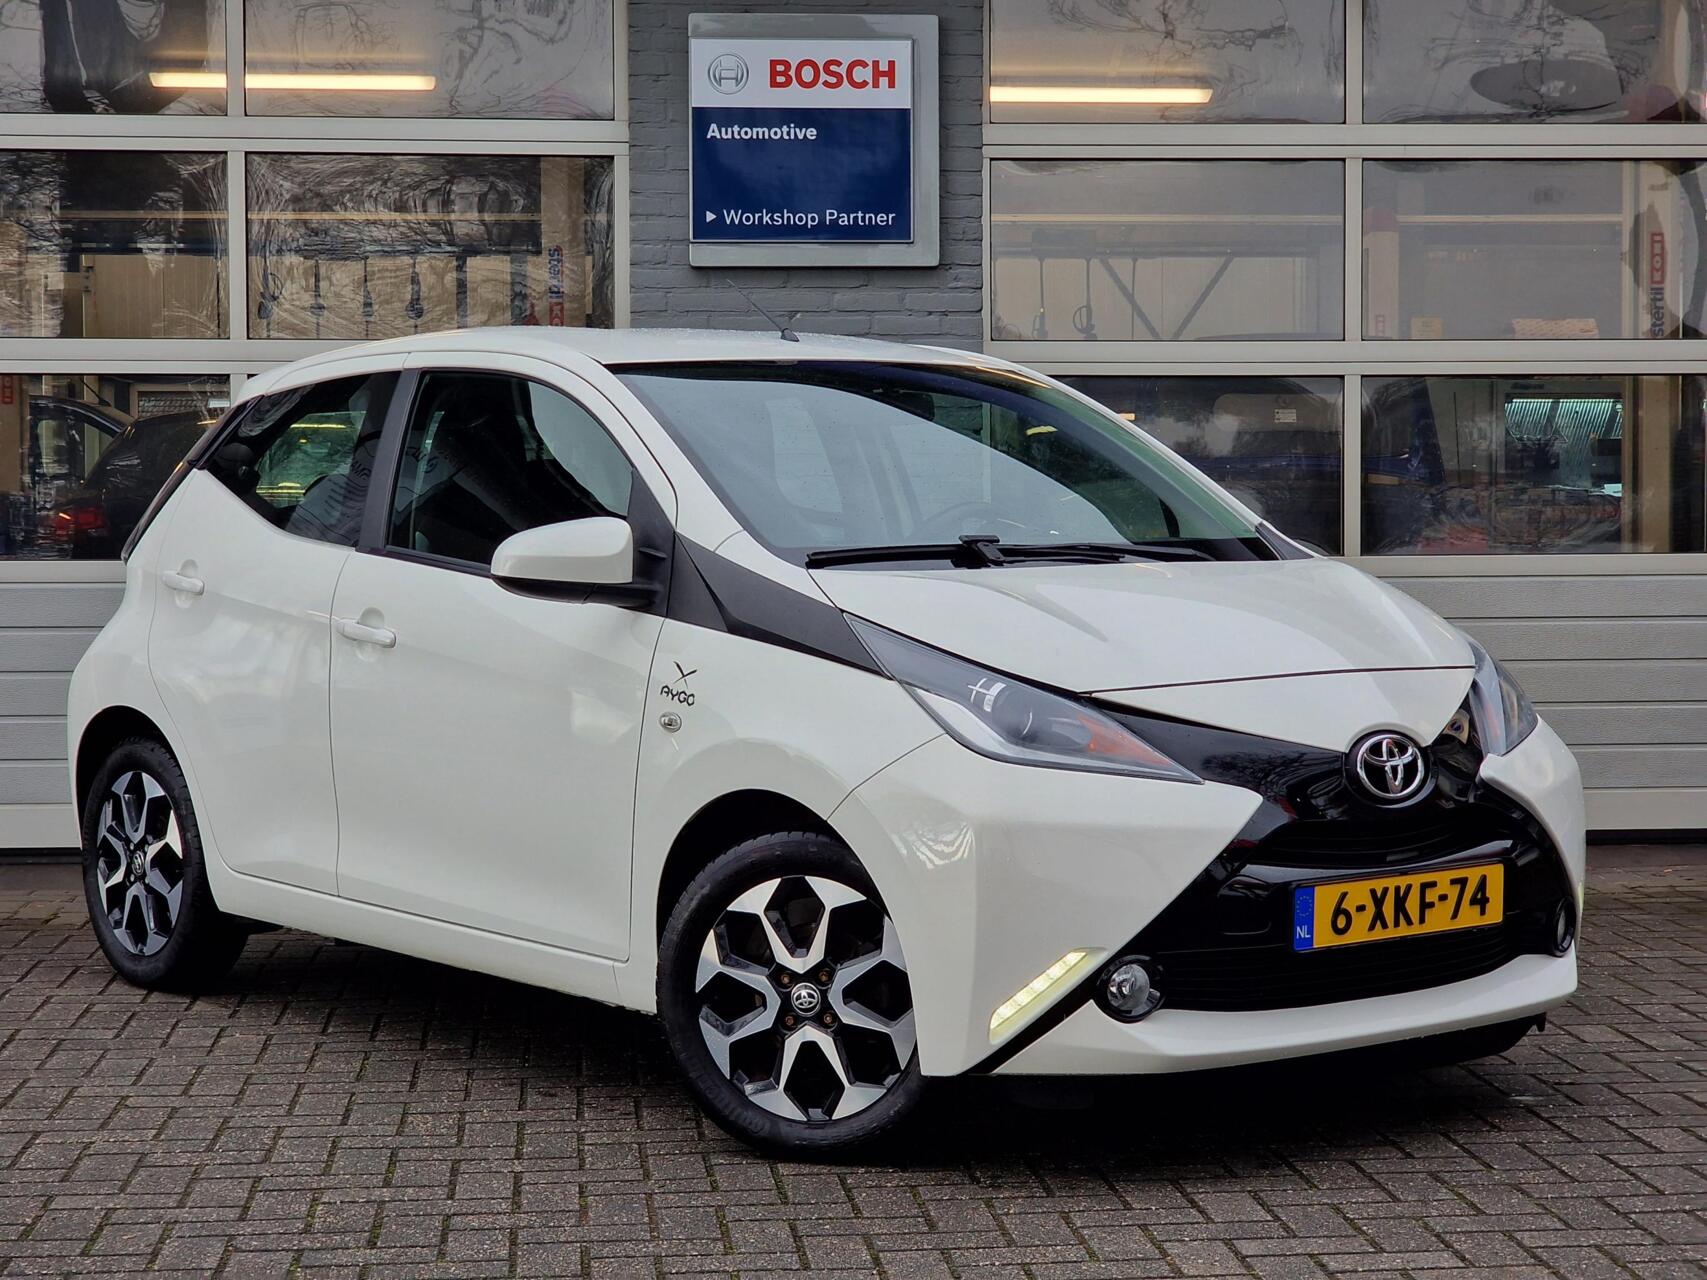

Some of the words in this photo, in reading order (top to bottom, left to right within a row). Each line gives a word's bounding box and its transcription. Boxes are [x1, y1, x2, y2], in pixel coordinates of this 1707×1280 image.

[769, 59, 896, 89] BOSCH
[706, 123, 818, 140] Automotive
[723, 209, 819, 228] Workshop
[825, 209, 896, 226] Partner
[1651, 287, 1664, 338] stertil
[660, 685, 695, 706] AYGO
[1330, 873, 1490, 936] 6-XKF-74
[1296, 925, 1311, 939] NL
